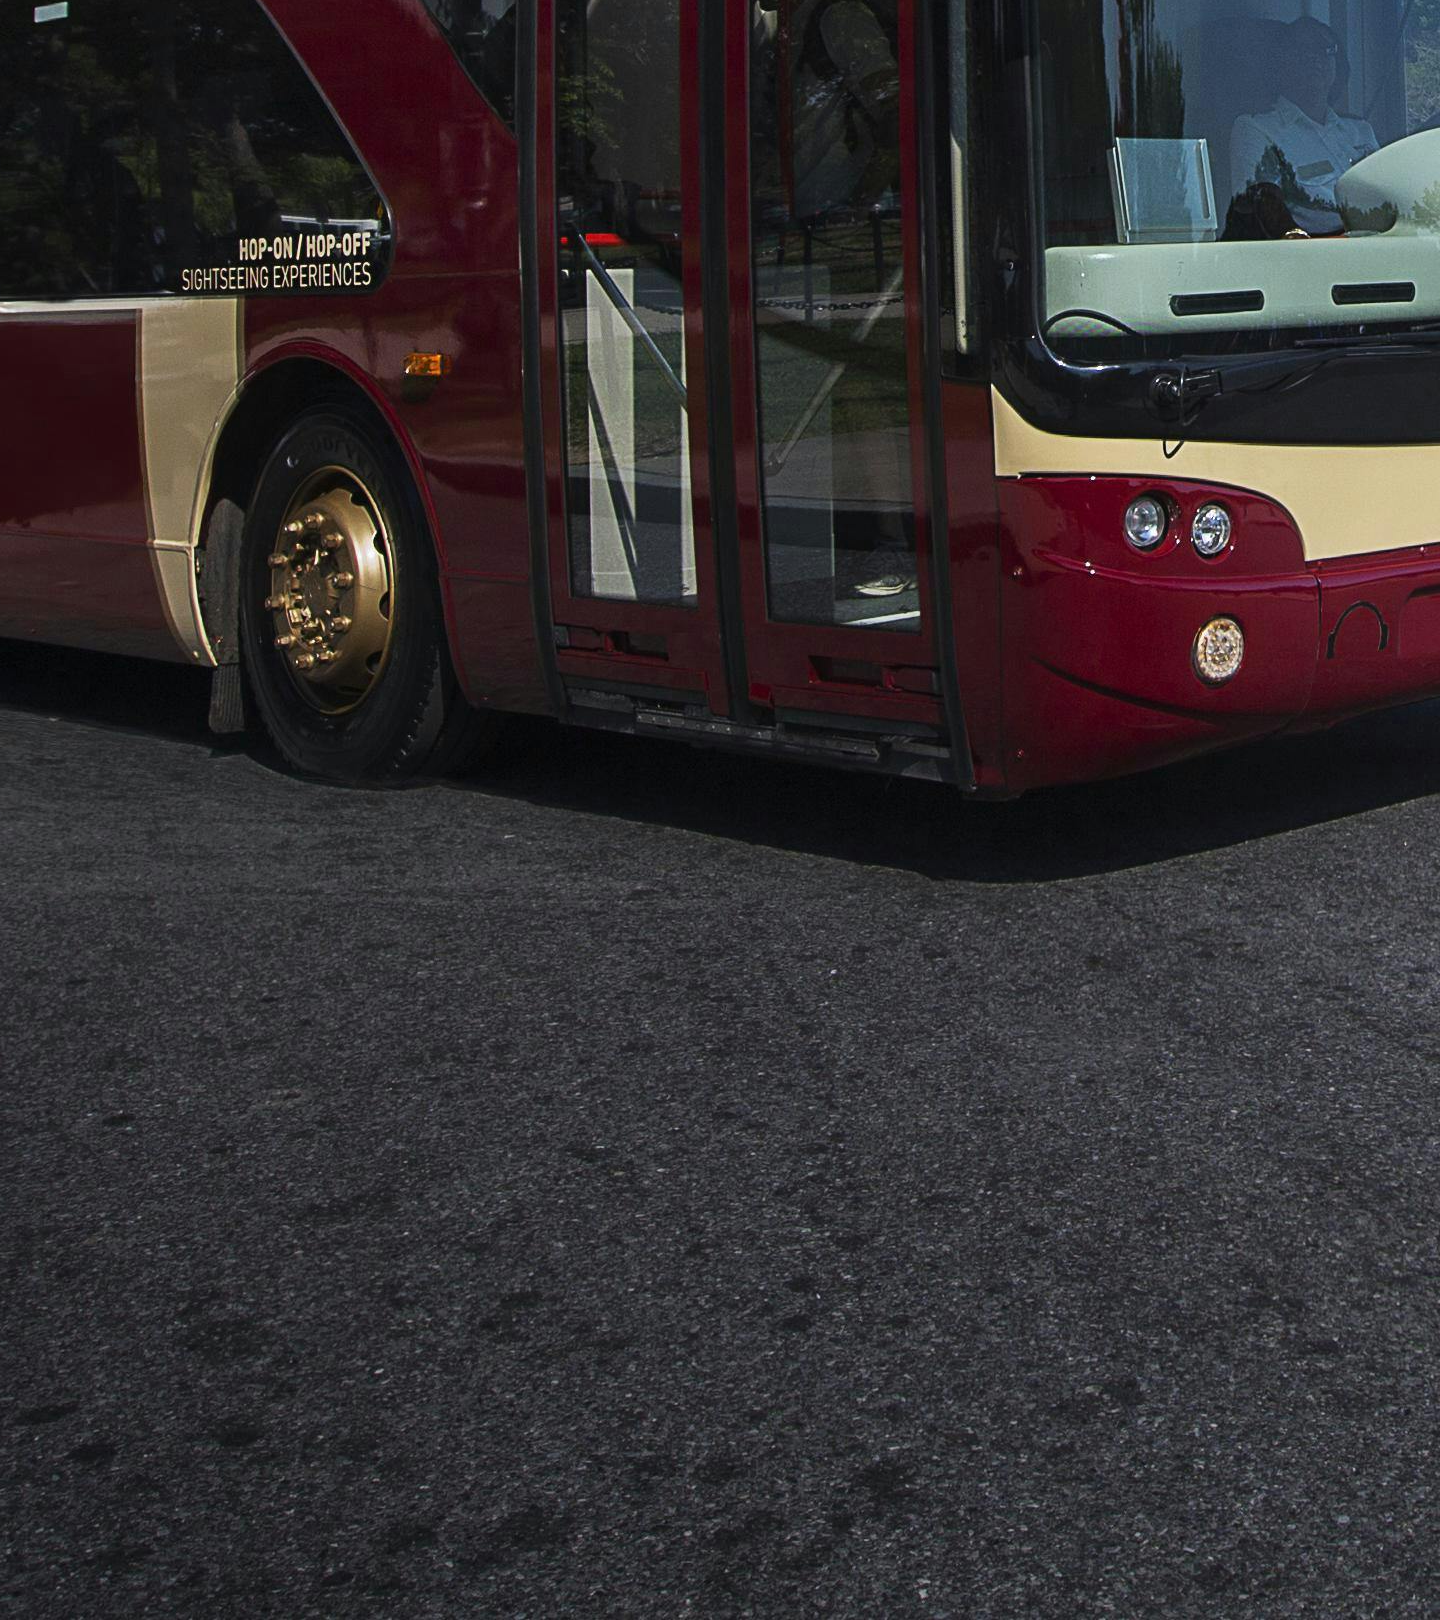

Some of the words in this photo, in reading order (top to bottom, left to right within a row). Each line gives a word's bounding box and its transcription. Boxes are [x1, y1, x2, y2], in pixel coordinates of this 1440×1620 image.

[239, 236, 293, 261] HOP-ON
[306, 232, 372, 258] HOP-OFF
[182, 266, 269, 291] SIGHTSEEING
[273, 262, 372, 288] EXPERIENCES
